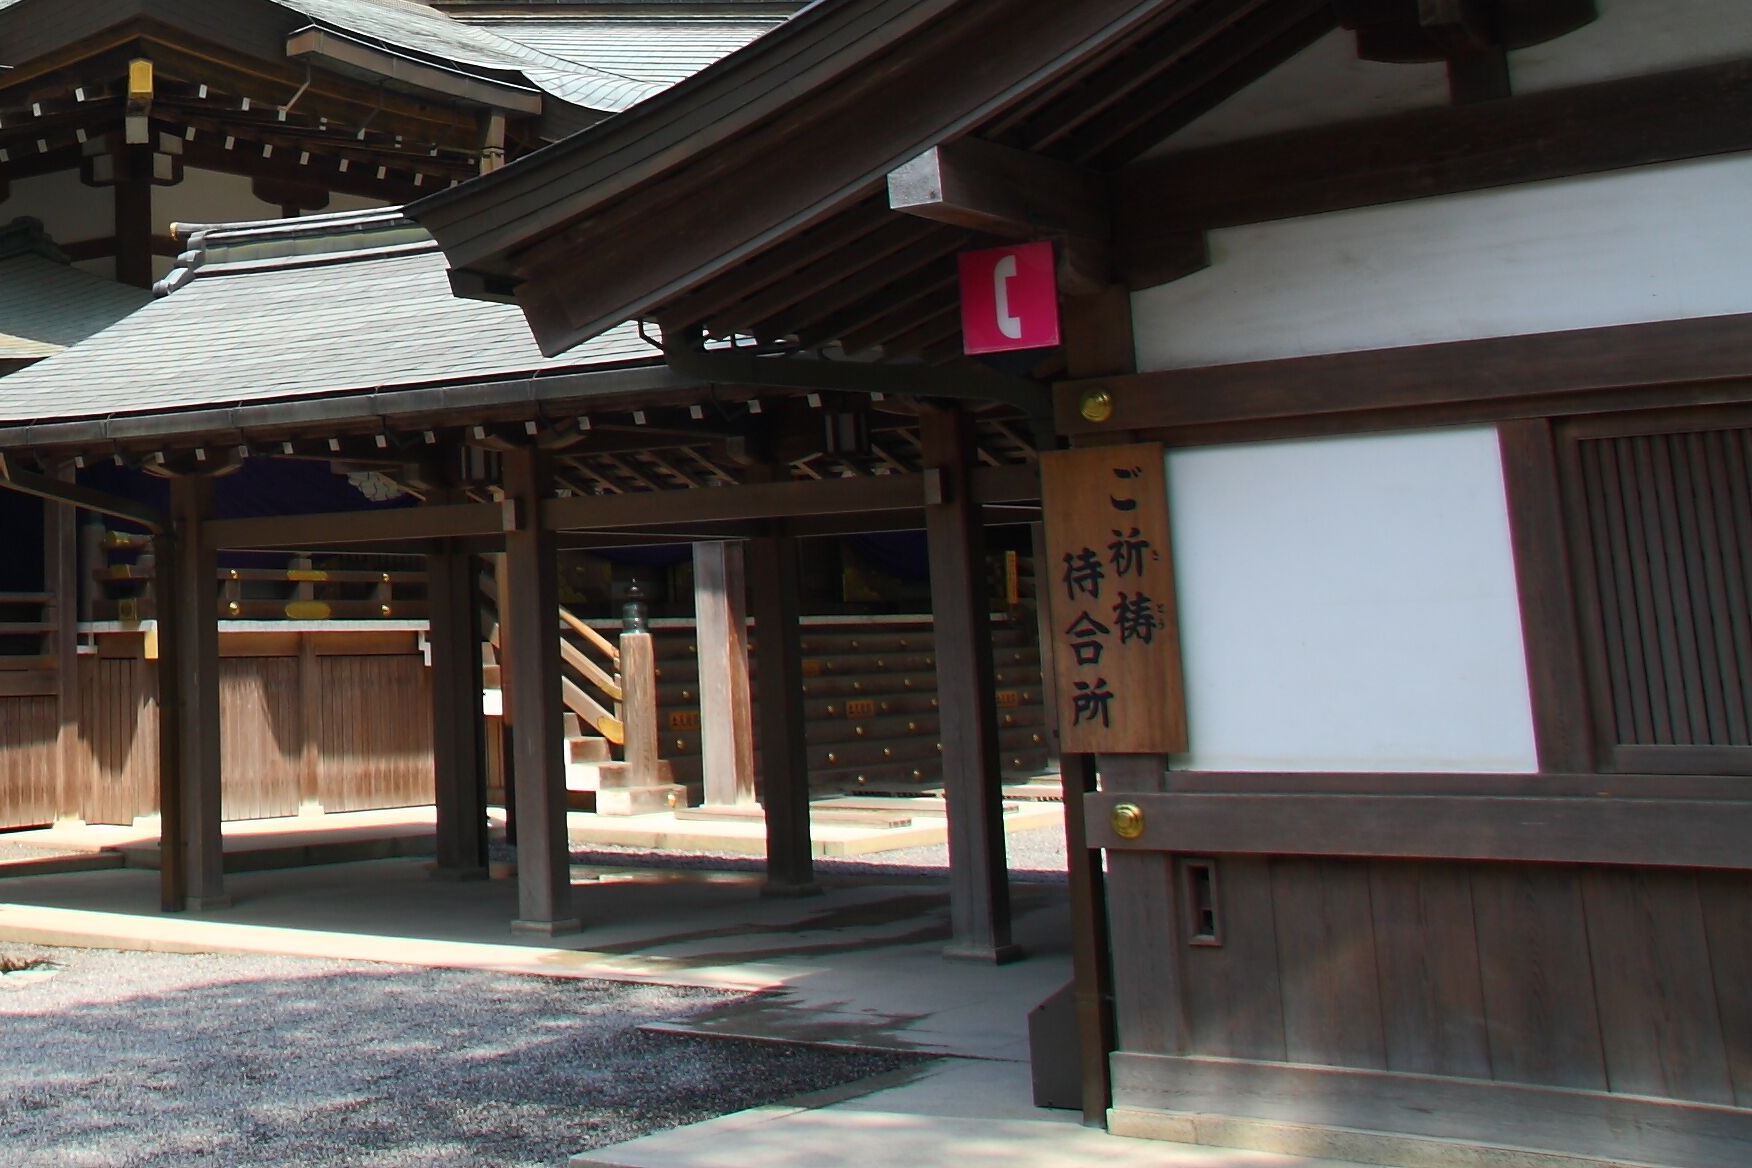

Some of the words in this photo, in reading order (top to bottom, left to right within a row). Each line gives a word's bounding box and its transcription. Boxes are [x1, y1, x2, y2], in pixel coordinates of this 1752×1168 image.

[1062, 547, 1115, 729] 待合所
[1107, 464, 1157, 646] ご祈祷
